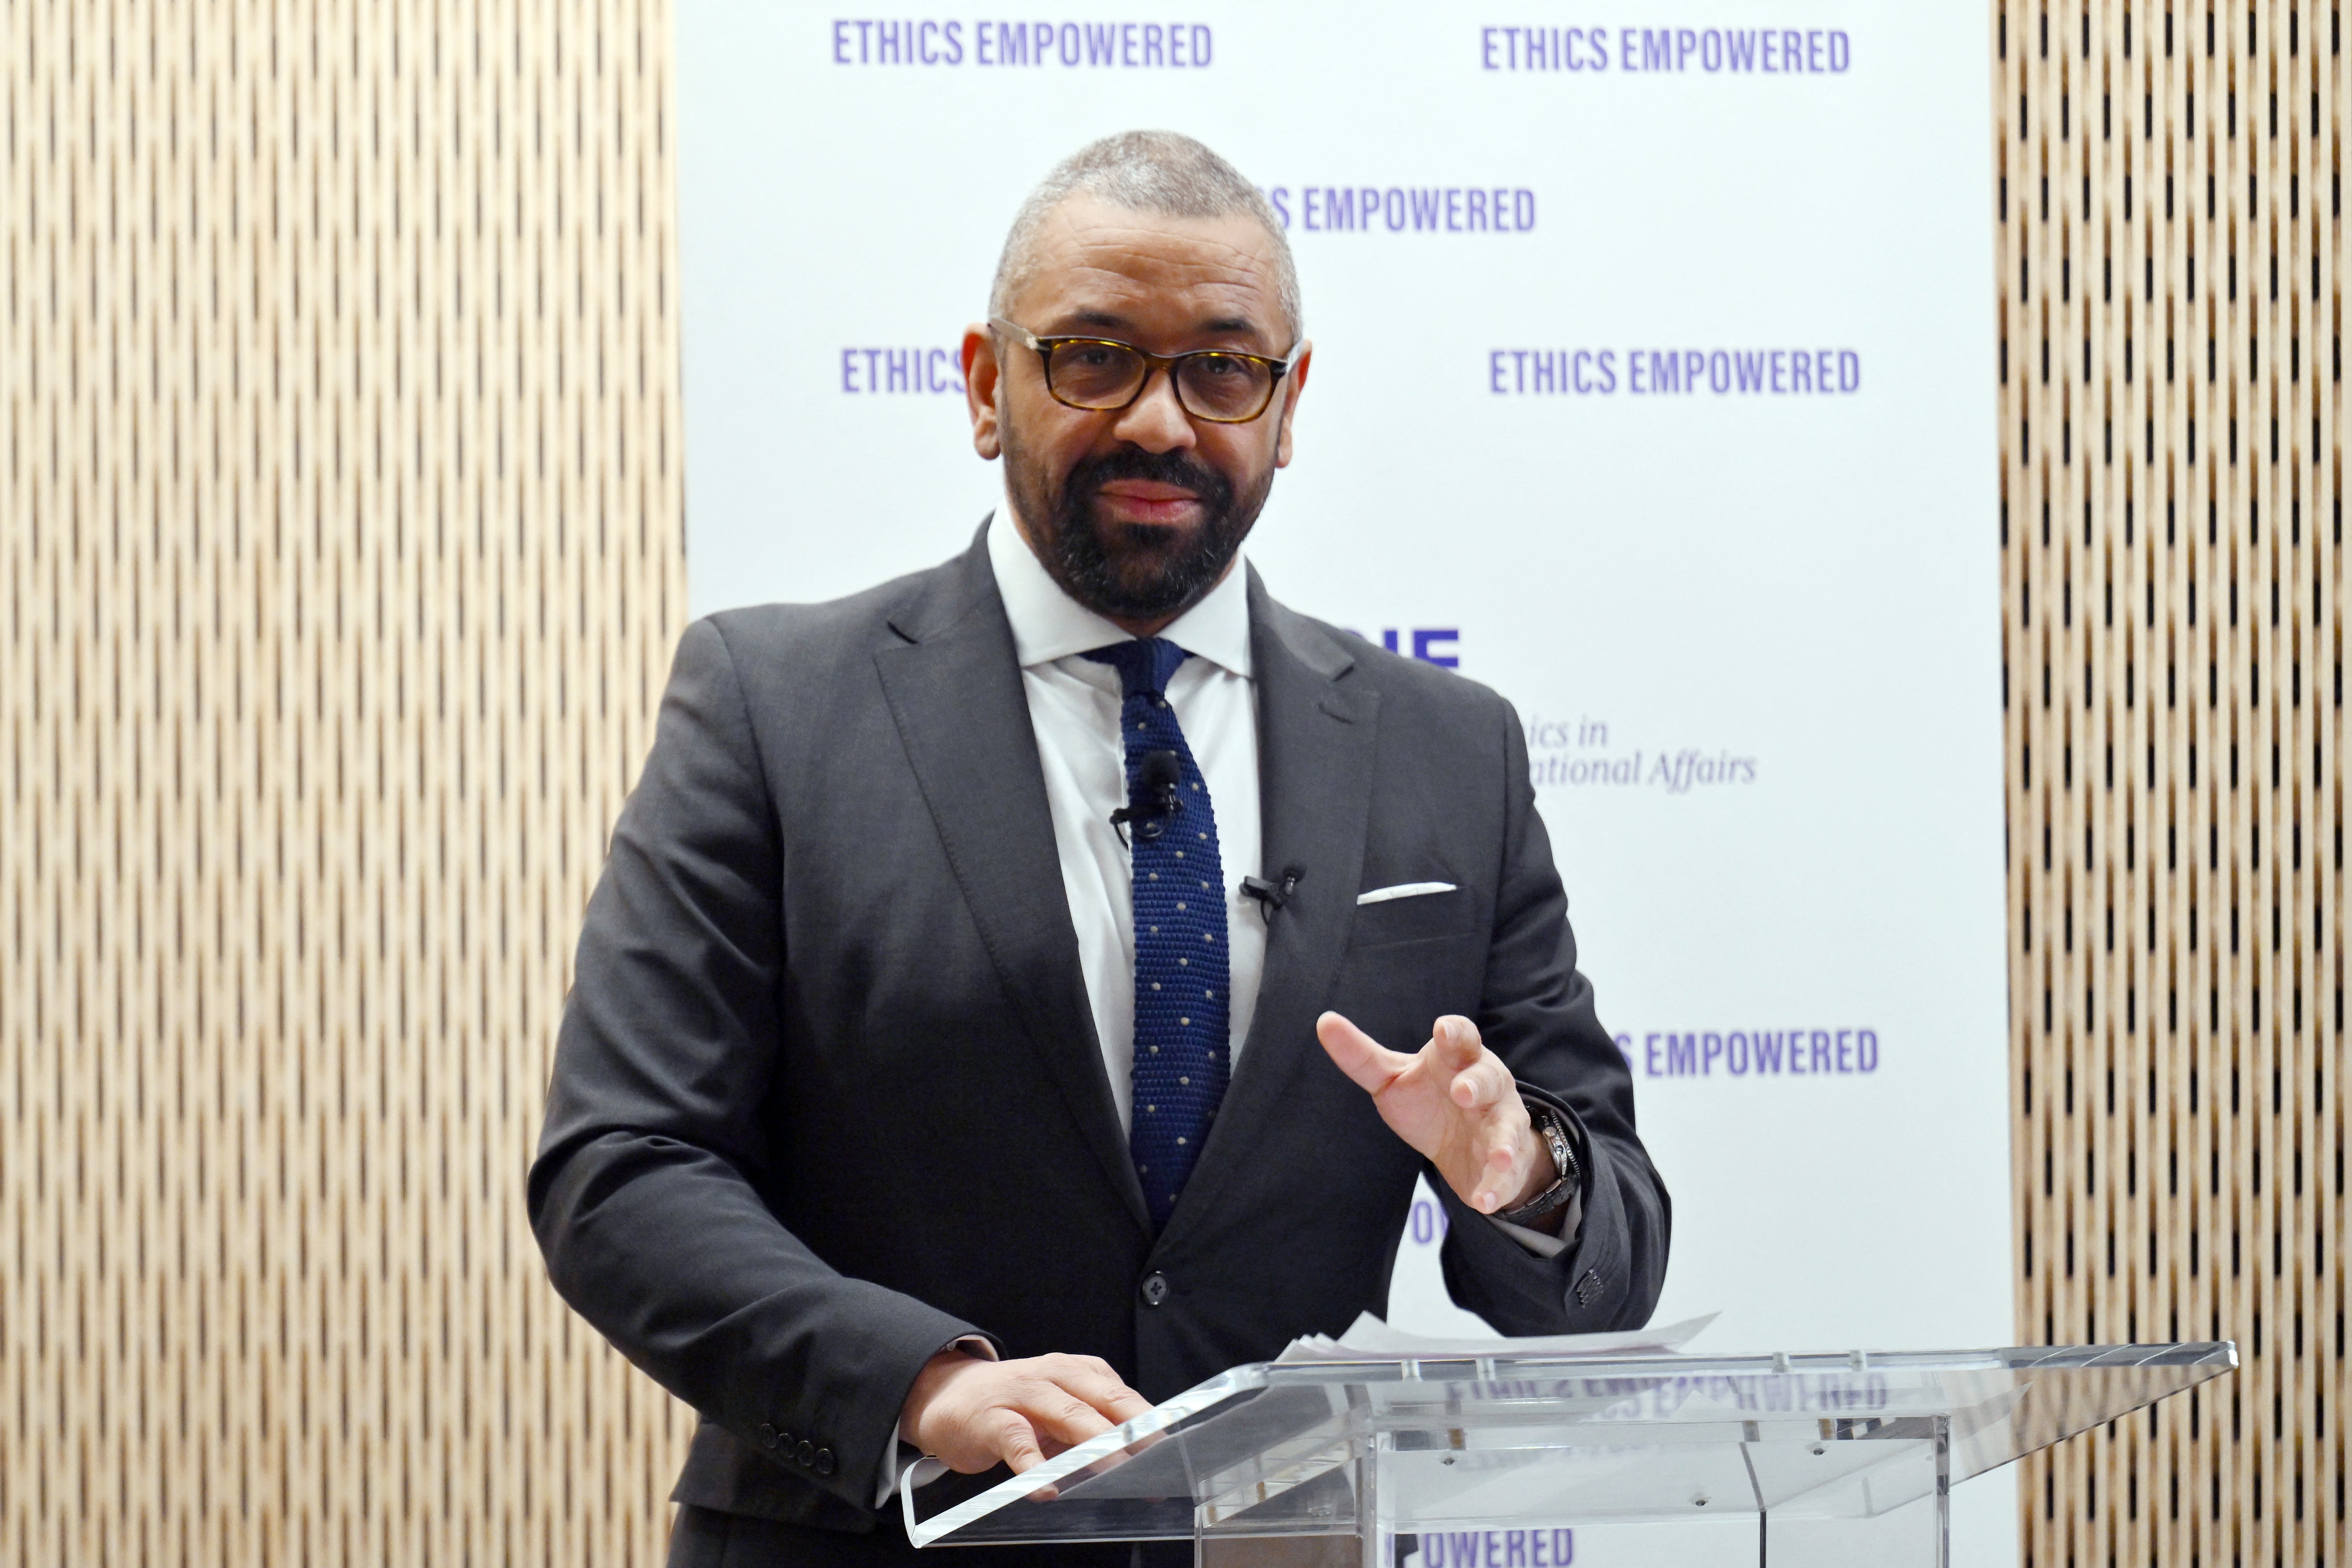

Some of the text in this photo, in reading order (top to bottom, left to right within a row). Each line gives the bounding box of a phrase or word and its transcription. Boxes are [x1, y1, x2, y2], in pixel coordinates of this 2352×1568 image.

[834, 20, 1212, 68] ETHICS EMPOWERED
[1482, 27, 1850, 73] ETHICS EMPOWERED
[1304, 188, 1535, 232] EMPOWERED
[1490, 351, 1860, 394] ETHICS EMPOWERED
[1530, 713, 1608, 748] ics in
[1530, 749, 1756, 794] ational Affairs
[1646, 1030, 1878, 1077] EMPOWERED
[1384, 1529, 1573, 1568] OWERED
